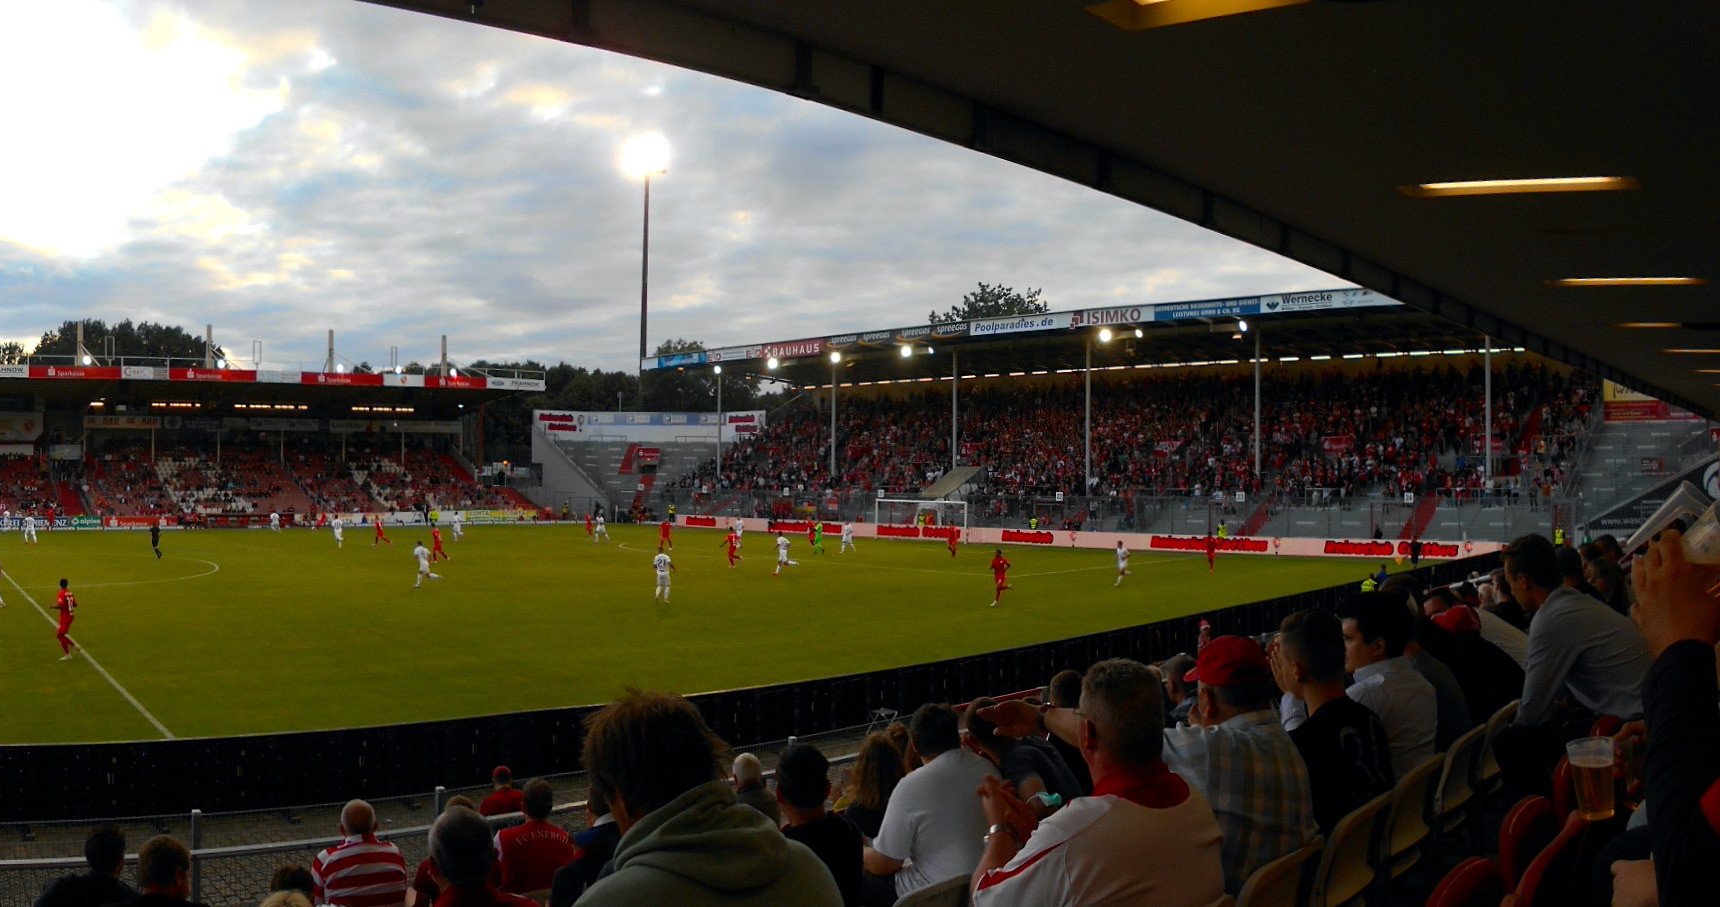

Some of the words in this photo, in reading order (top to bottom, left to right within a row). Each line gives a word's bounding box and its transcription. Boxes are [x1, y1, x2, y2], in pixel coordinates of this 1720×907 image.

[1282, 292, 1333, 305] Wernecke
[1086, 308, 1141, 325] ISIMKO
[772, 343, 820, 357] BAUHAUS
[79, 518, 101, 526] alpina
[657, 558, 666, 567] 21
